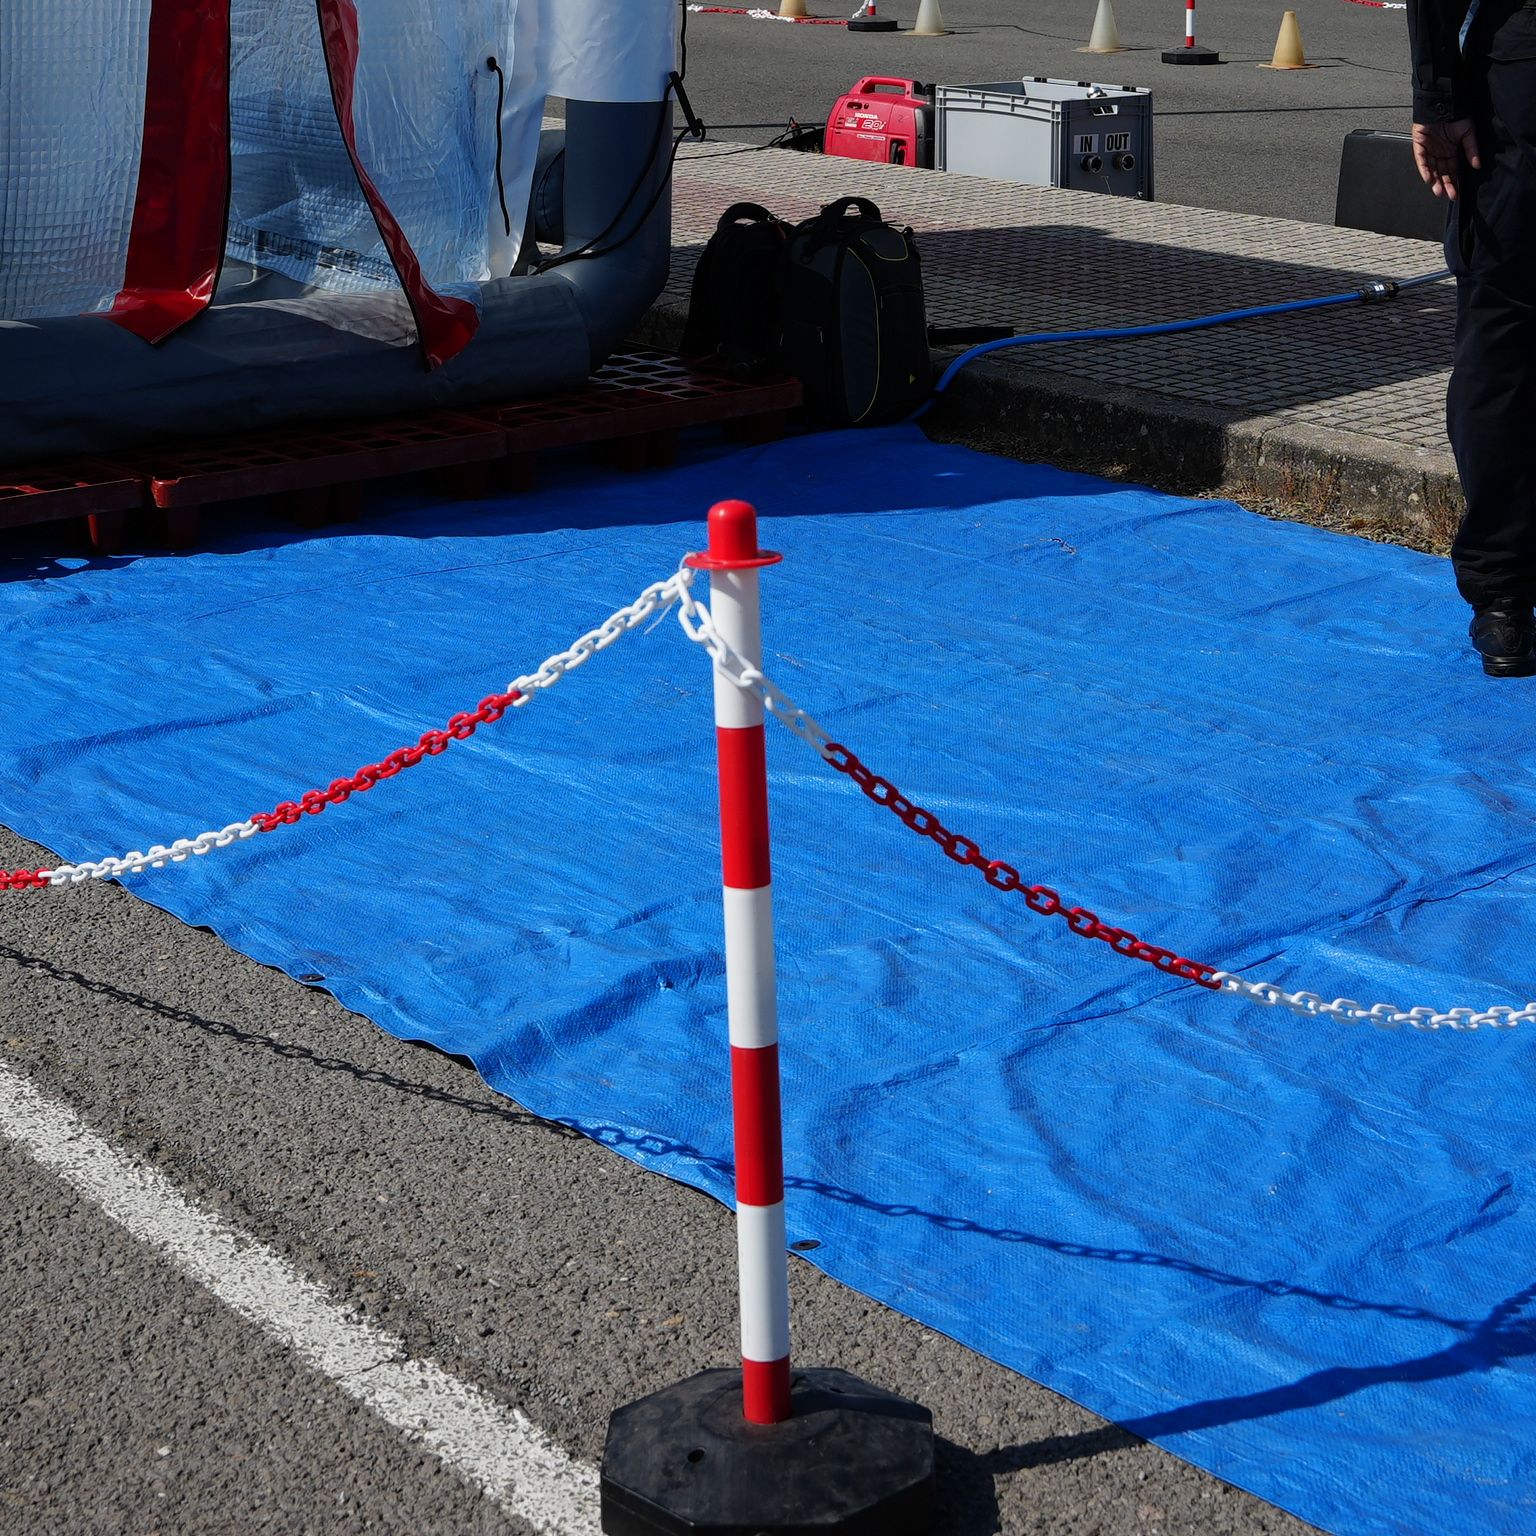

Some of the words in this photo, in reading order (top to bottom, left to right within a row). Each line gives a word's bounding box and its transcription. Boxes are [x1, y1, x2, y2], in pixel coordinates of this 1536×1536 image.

[854, 112, 879, 120] HONDA
[1080, 135, 1093, 152] IN
[1106, 133, 1129, 151] OUT
